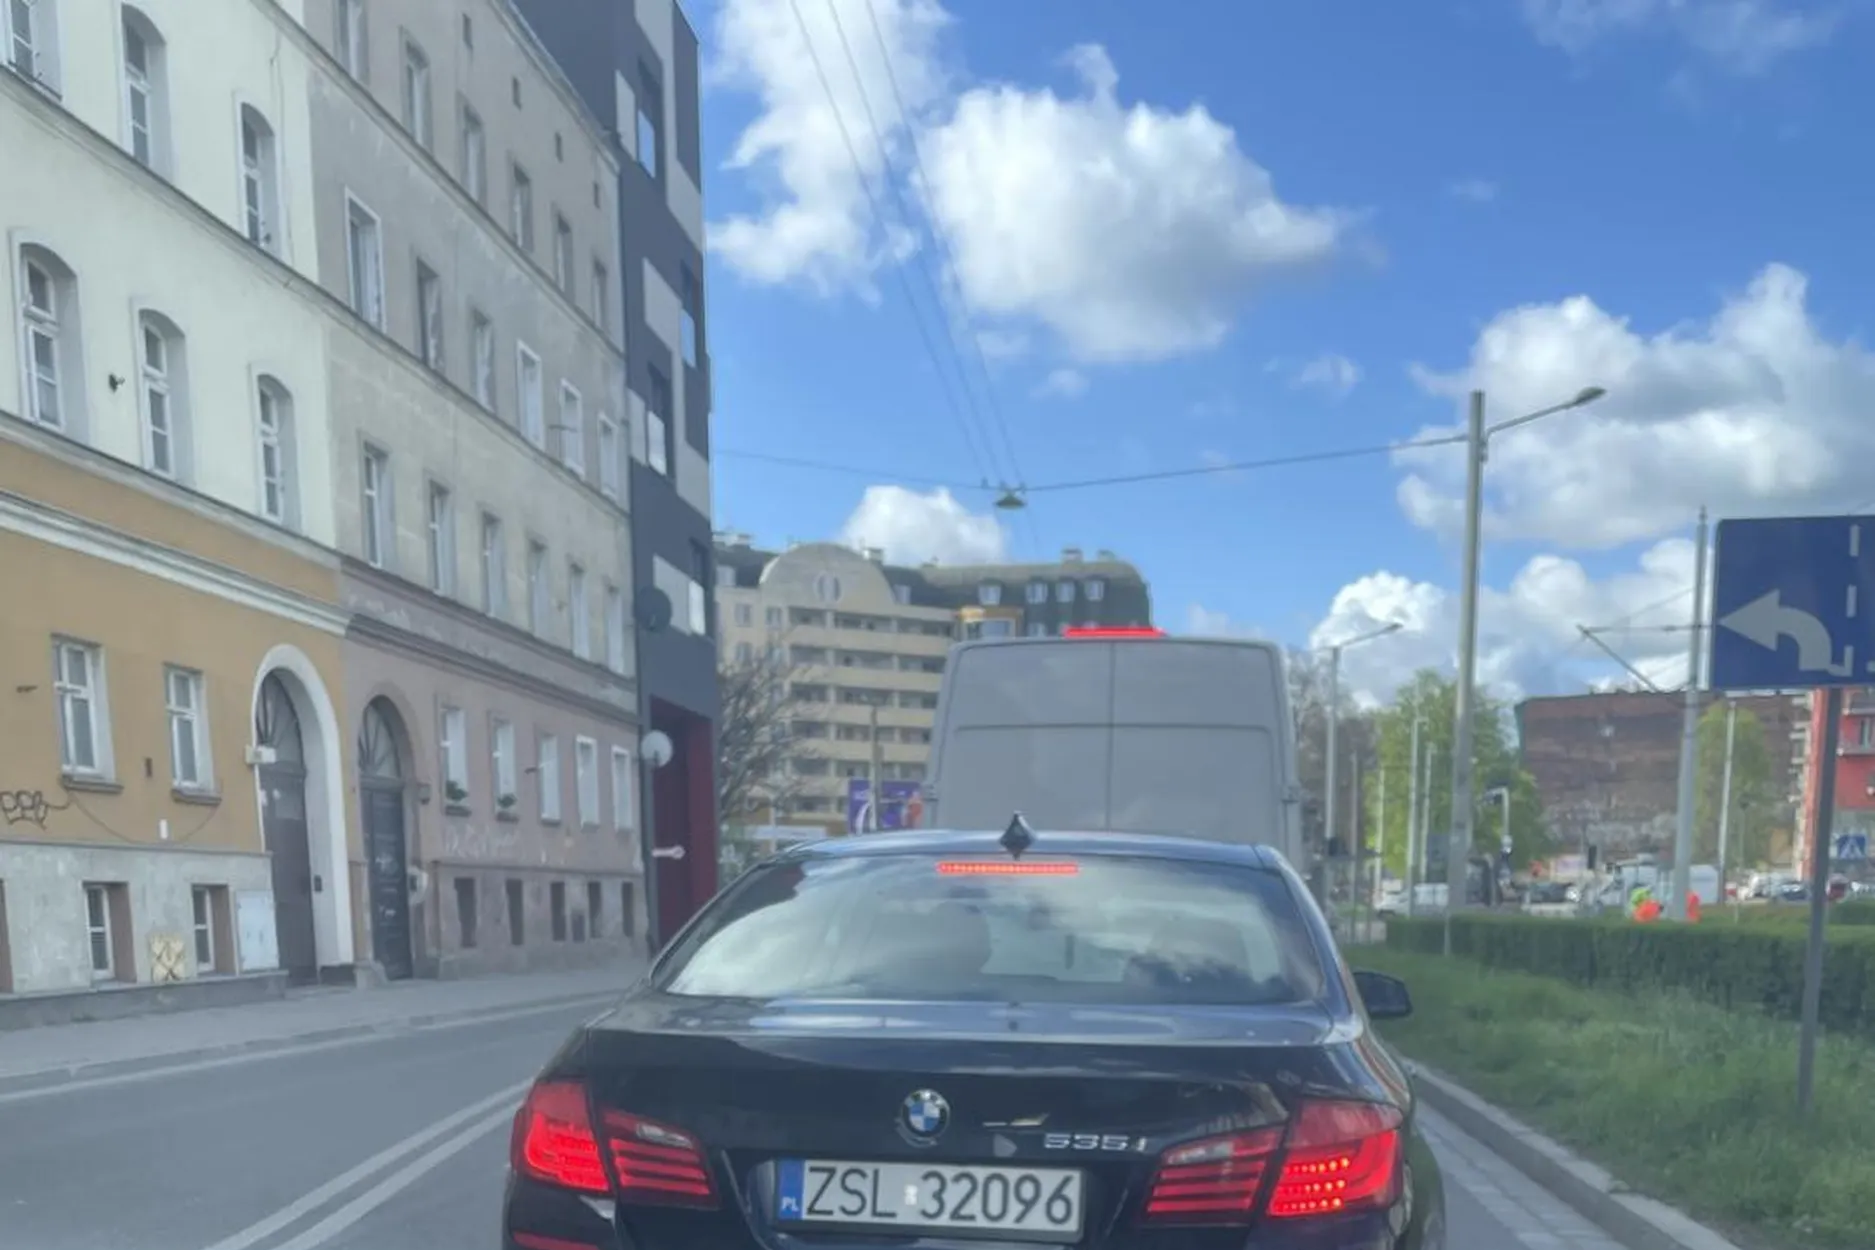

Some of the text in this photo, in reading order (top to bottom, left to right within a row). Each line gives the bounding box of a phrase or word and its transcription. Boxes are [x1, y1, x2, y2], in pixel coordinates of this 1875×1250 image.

[1044, 1133, 1148, 1152] 535i
[781, 1196, 800, 1212] PL
[806, 1165, 1076, 1226] ZSL 32096
